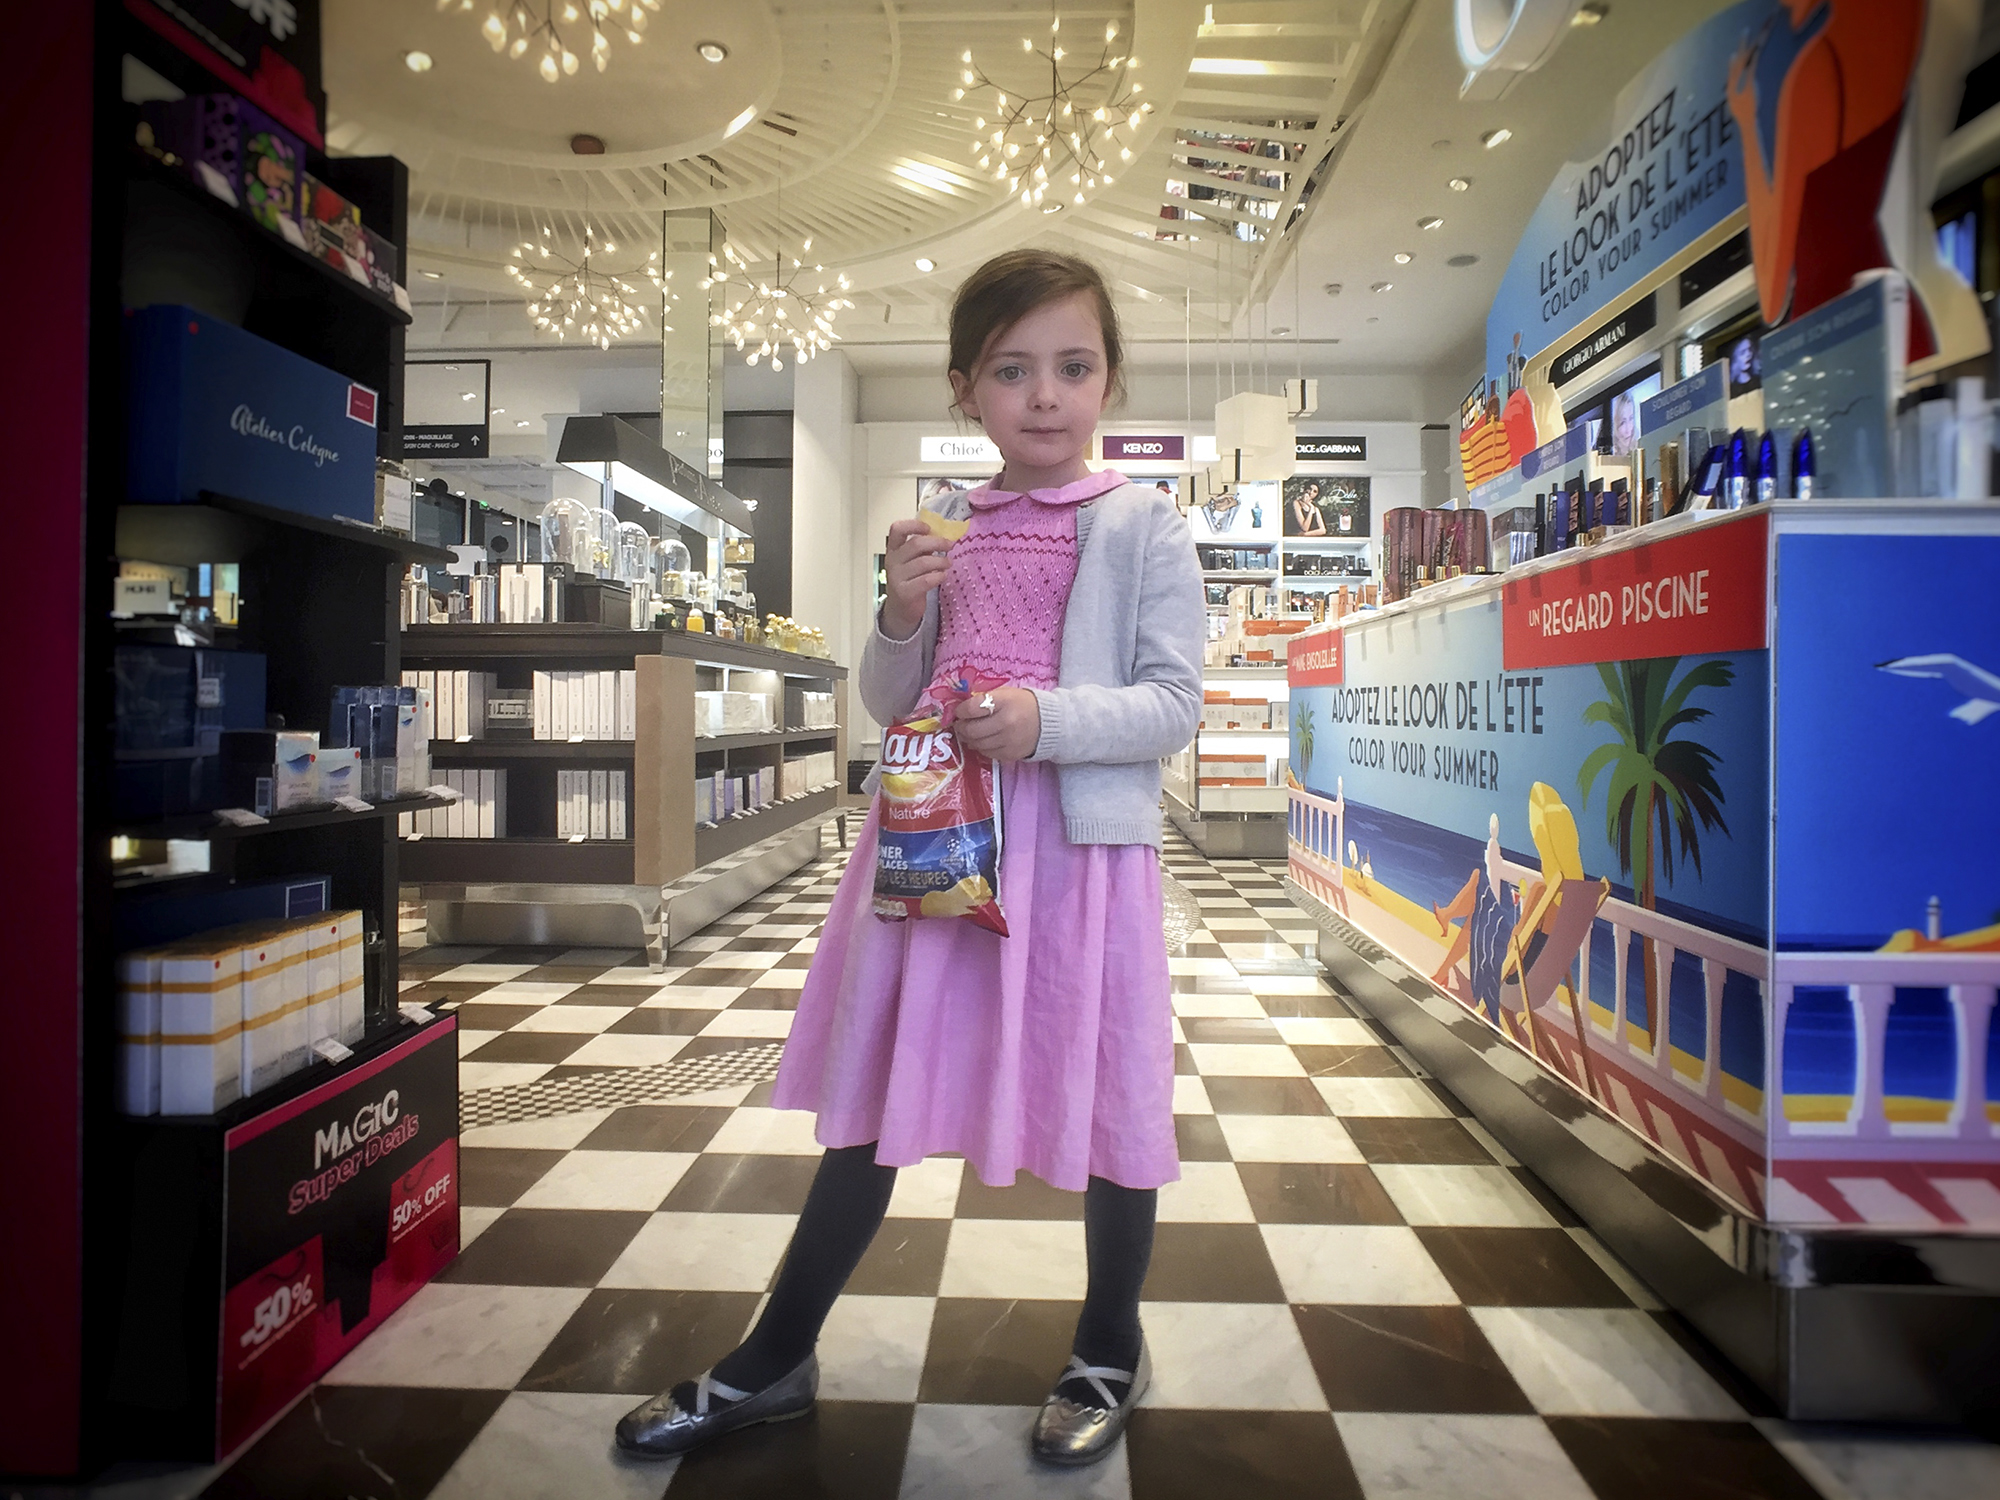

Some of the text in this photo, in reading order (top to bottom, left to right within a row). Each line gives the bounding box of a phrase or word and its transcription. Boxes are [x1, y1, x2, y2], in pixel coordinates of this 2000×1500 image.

[1575, 86, 1677, 220] ADOPTEZ
[1540, 250, 1557, 296] LE
[1563, 193, 1620, 277] LOOK
[1629, 162, 1655, 223] DE
[1543, 159, 1728, 322] COLOR YOUR SUMMER
[1563, 321, 1626, 374] GIORGIO ARMANI
[230, 403, 340, 468] Atelier Cologne
[940, 442, 983, 456] Chloé
[1122, 442, 1164, 454] KENZO
[1528, 569, 1709, 637] UN REGARD PISCINE
[1332, 687, 1380, 725] ADOPTEZ
[1385, 686, 1398, 726] LE
[1403, 682, 1449, 729] LOOK
[1456, 681, 1477, 731] DE
[1349, 736, 1499, 792] COLOR YOUR SUMMER
[889, 807, 930, 820] Nature
[314, 1089, 399, 1170] MAGIC
[287, 1114, 419, 1215] Super Deals
[391, 1194, 422, 1232] 50%
[424, 1173, 450, 1206] OFF
[240, 1273, 313, 1348] -50%
